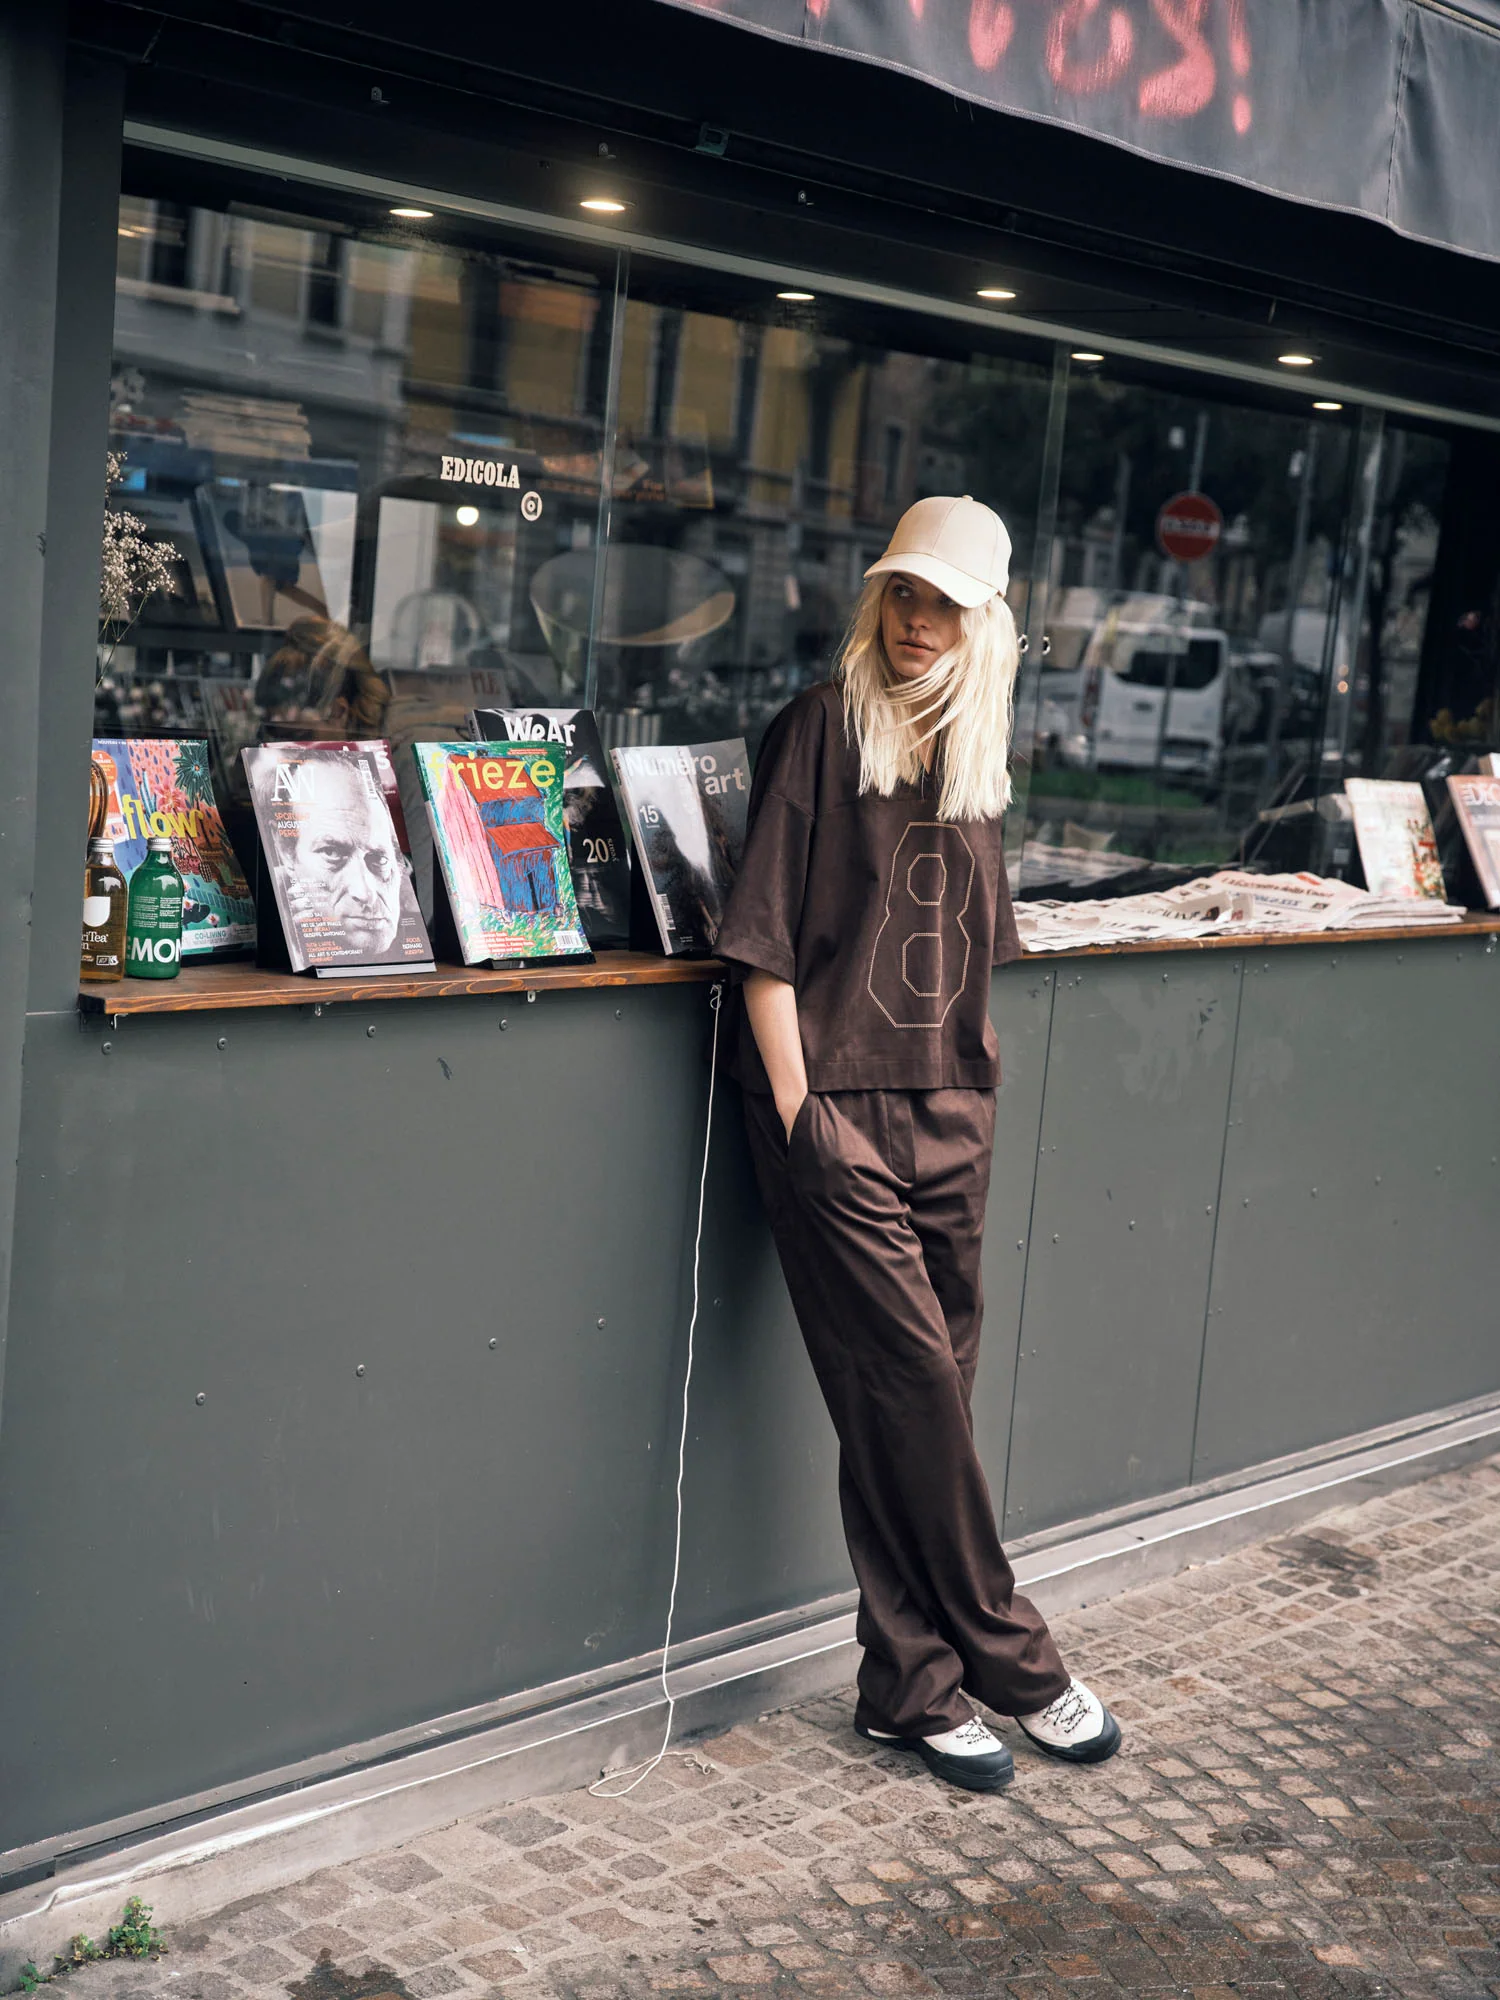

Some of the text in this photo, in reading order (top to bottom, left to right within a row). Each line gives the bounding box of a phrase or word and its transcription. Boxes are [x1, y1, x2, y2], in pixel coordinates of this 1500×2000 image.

[440, 455, 520, 489] EDICOLA
[503, 716, 576, 747] WeAr
[428, 751, 556, 790] frieze
[704, 767, 746, 795] art
[122, 794, 204, 839] flow
[640, 807, 659, 824] 15
[583, 838, 609, 863] 20
[867, 821, 975, 1028] 8
